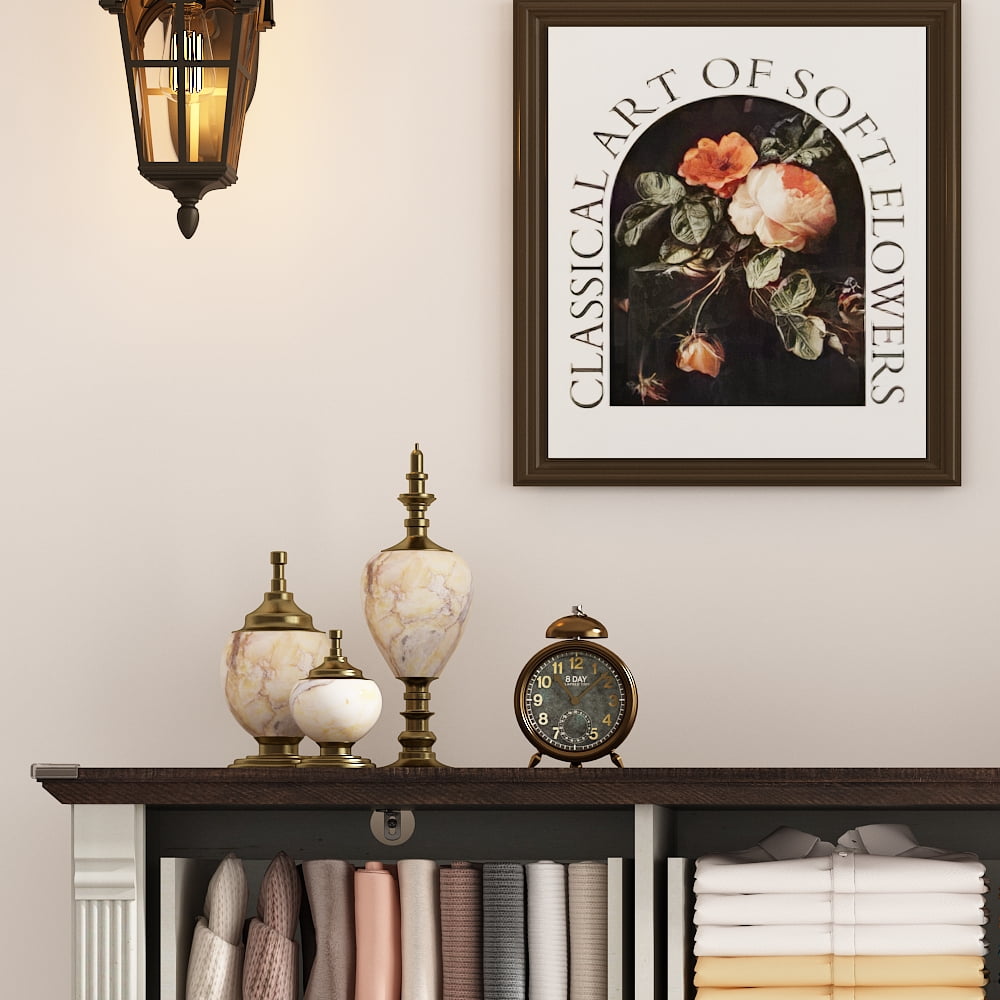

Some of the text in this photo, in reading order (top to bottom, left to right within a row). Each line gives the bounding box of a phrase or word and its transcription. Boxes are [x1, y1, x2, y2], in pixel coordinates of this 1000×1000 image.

[570, 170, 609, 409] CLASSICAL
[593, 68, 682, 159] ART
[702, 57, 774, 89] OF
[785, 68, 896, 168] SOFT
[552, 661, 563, 675] 11
[569, 657, 584, 669] 12
[592, 663, 597, 675] 1
[536, 675, 552, 689] 10
[565, 675, 588, 683] 8 DAY
[533, 693, 543, 707] 9
[608, 694, 618, 707] 3
[538, 712, 549, 726] 8
[602, 713, 612, 727] 4
[552, 726, 560, 740] 7
[588, 727, 599, 741] 5
